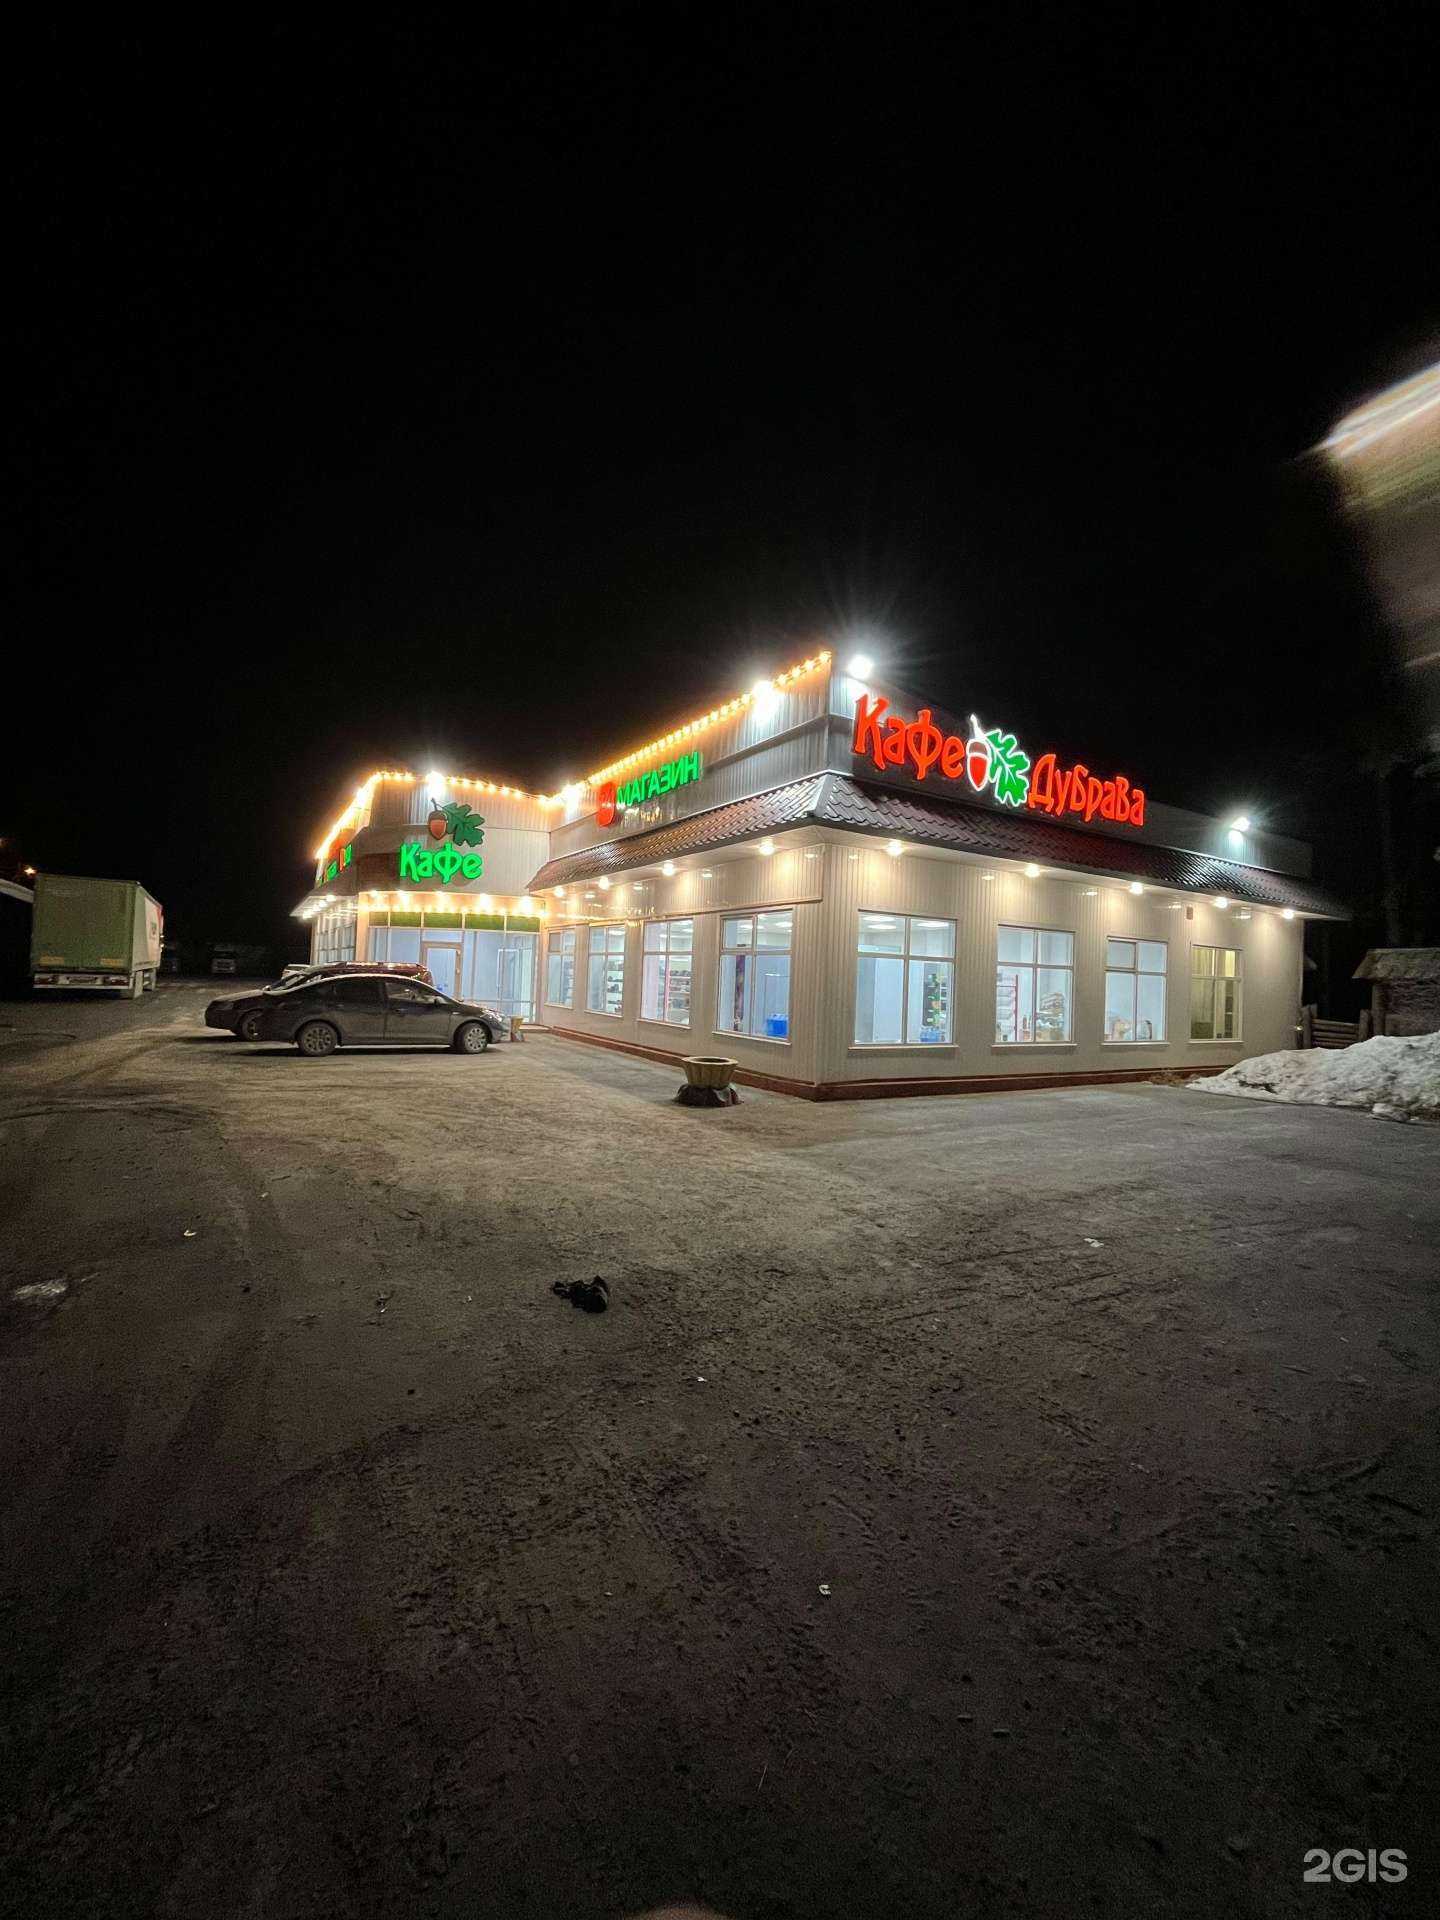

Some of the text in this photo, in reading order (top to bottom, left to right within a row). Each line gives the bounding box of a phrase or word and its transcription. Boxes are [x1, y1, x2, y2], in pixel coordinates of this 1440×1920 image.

[617, 751, 700, 807] МАГАЗИН
[854, 694, 1146, 826] Кафе Дубрава
[400, 841, 483, 884] Кафе
